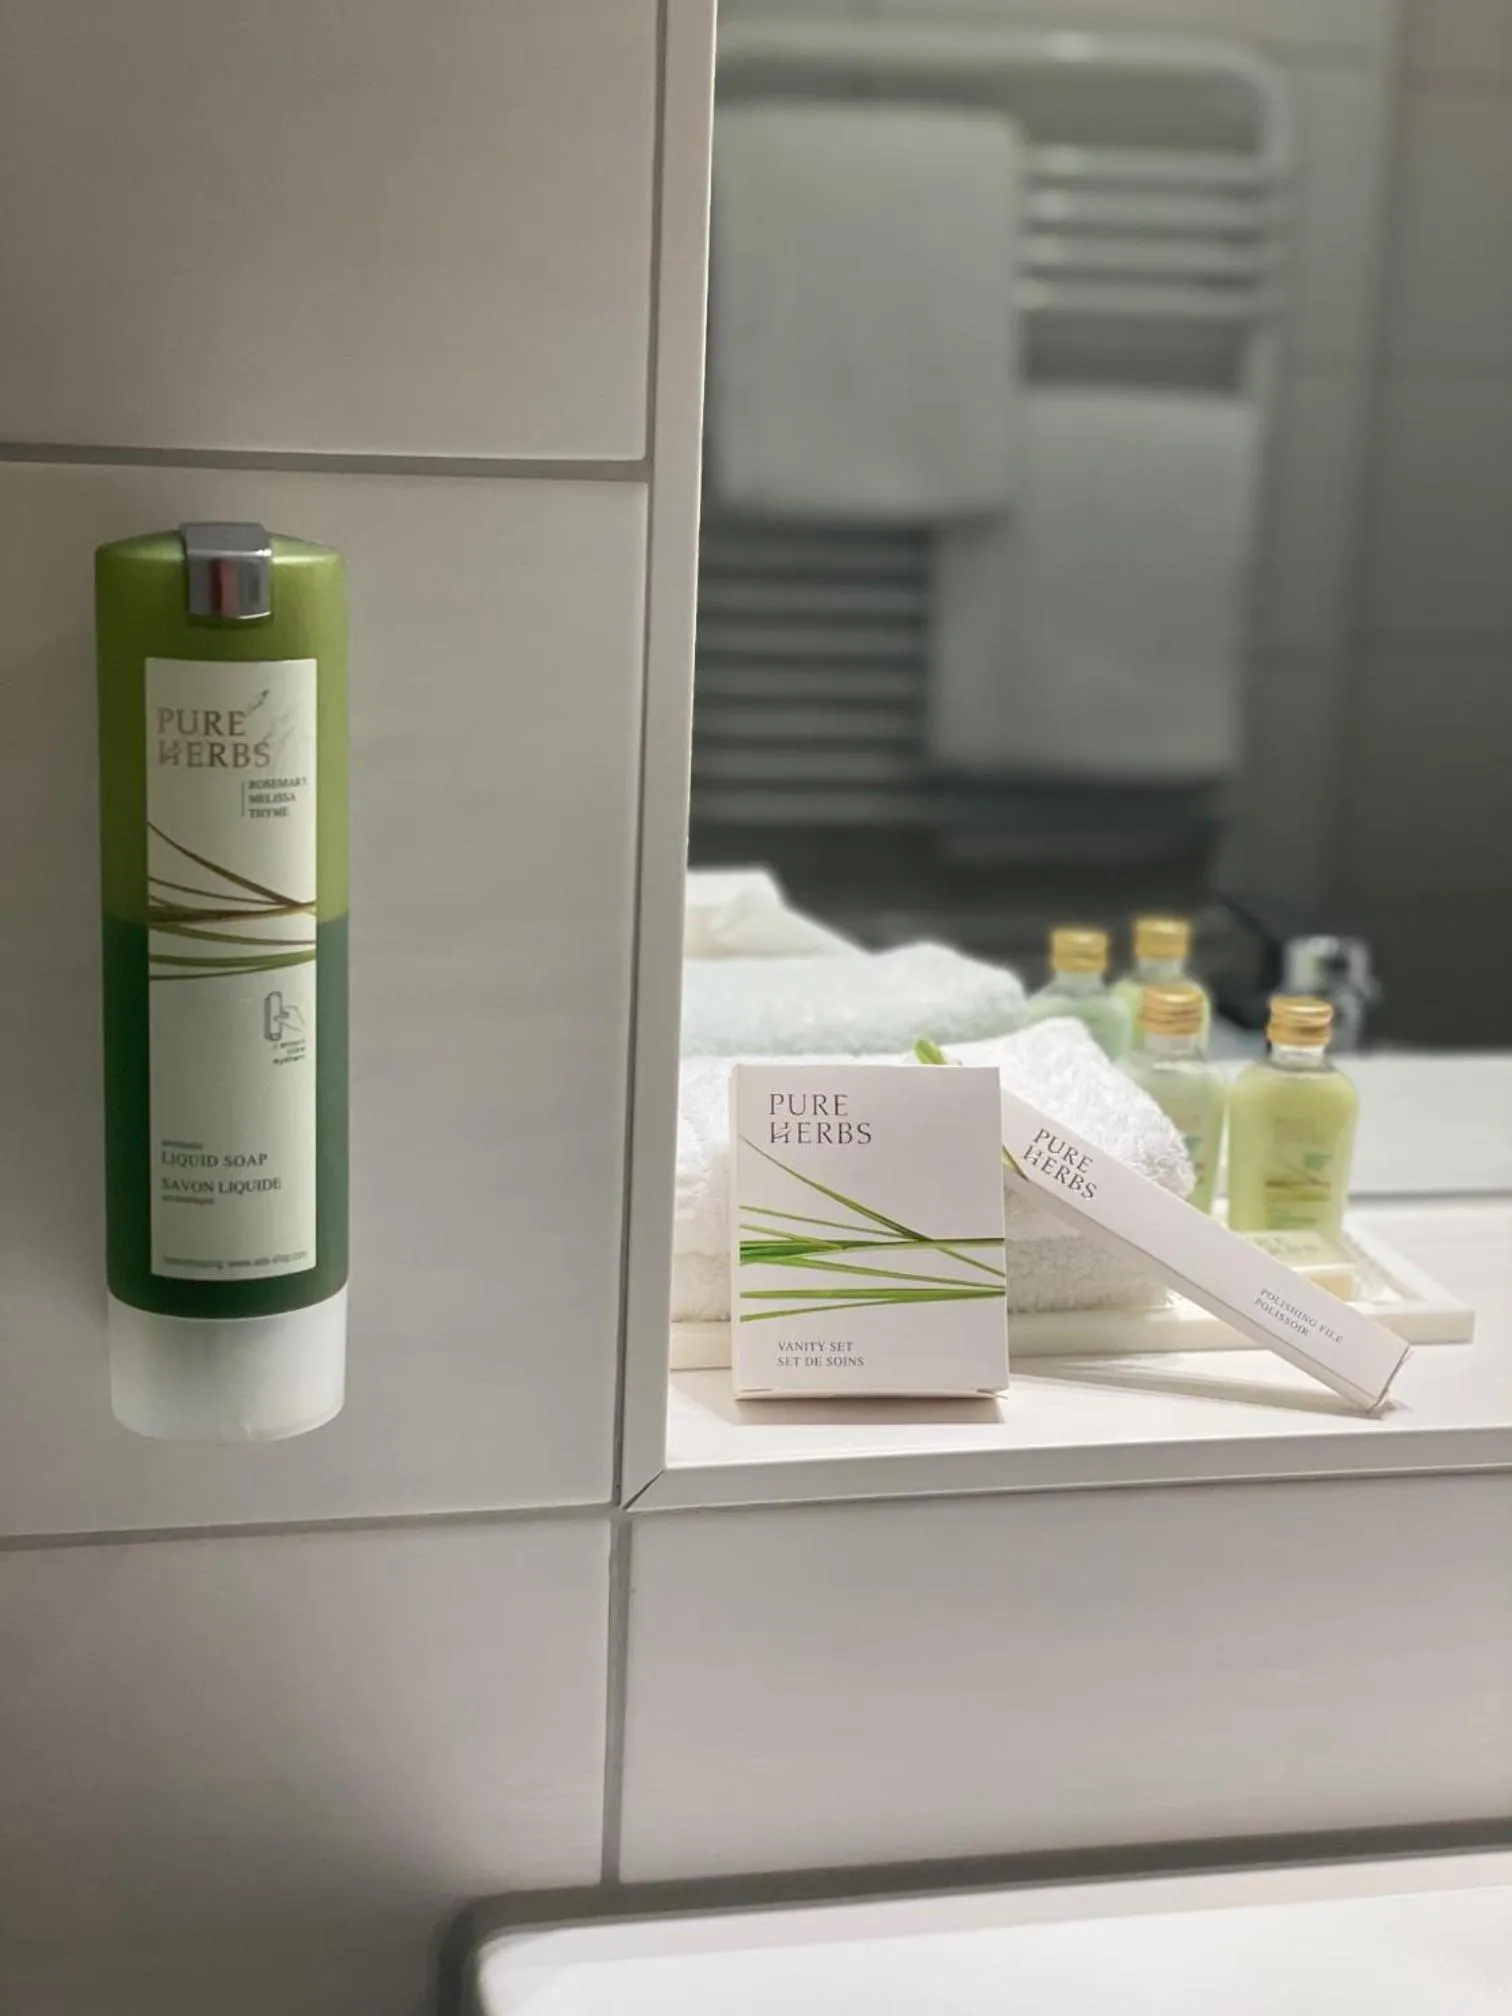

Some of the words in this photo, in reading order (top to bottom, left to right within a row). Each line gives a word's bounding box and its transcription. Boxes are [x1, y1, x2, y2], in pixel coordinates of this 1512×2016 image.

[157, 707, 245, 736] PURE
[158, 740, 271, 768] HERBS
[248, 792, 297, 804] MELISSA
[249, 807, 290, 818] THYME
[769, 1093, 848, 1116] PURE
[770, 1121, 872, 1144] HERBS
[161, 1151, 219, 1168] LIQUID
[224, 1153, 267, 1168] SOAP
[1033, 1128, 1093, 1173] PURE
[1023, 1145, 1098, 1199] HERBS
[161, 1178, 214, 1193] SAVON
[218, 1178, 282, 1195] LIQUIDE
[1254, 1298, 1310, 1336] POLISSOIR
[1260, 1288, 1319, 1327] POLISHING
[778, 1341, 825, 1352] VANITY
[829, 1341, 854, 1352] SET
[777, 1356, 802, 1367] SET
[805, 1356, 822, 1367] DE
[826, 1356, 865, 1367] SOINS
